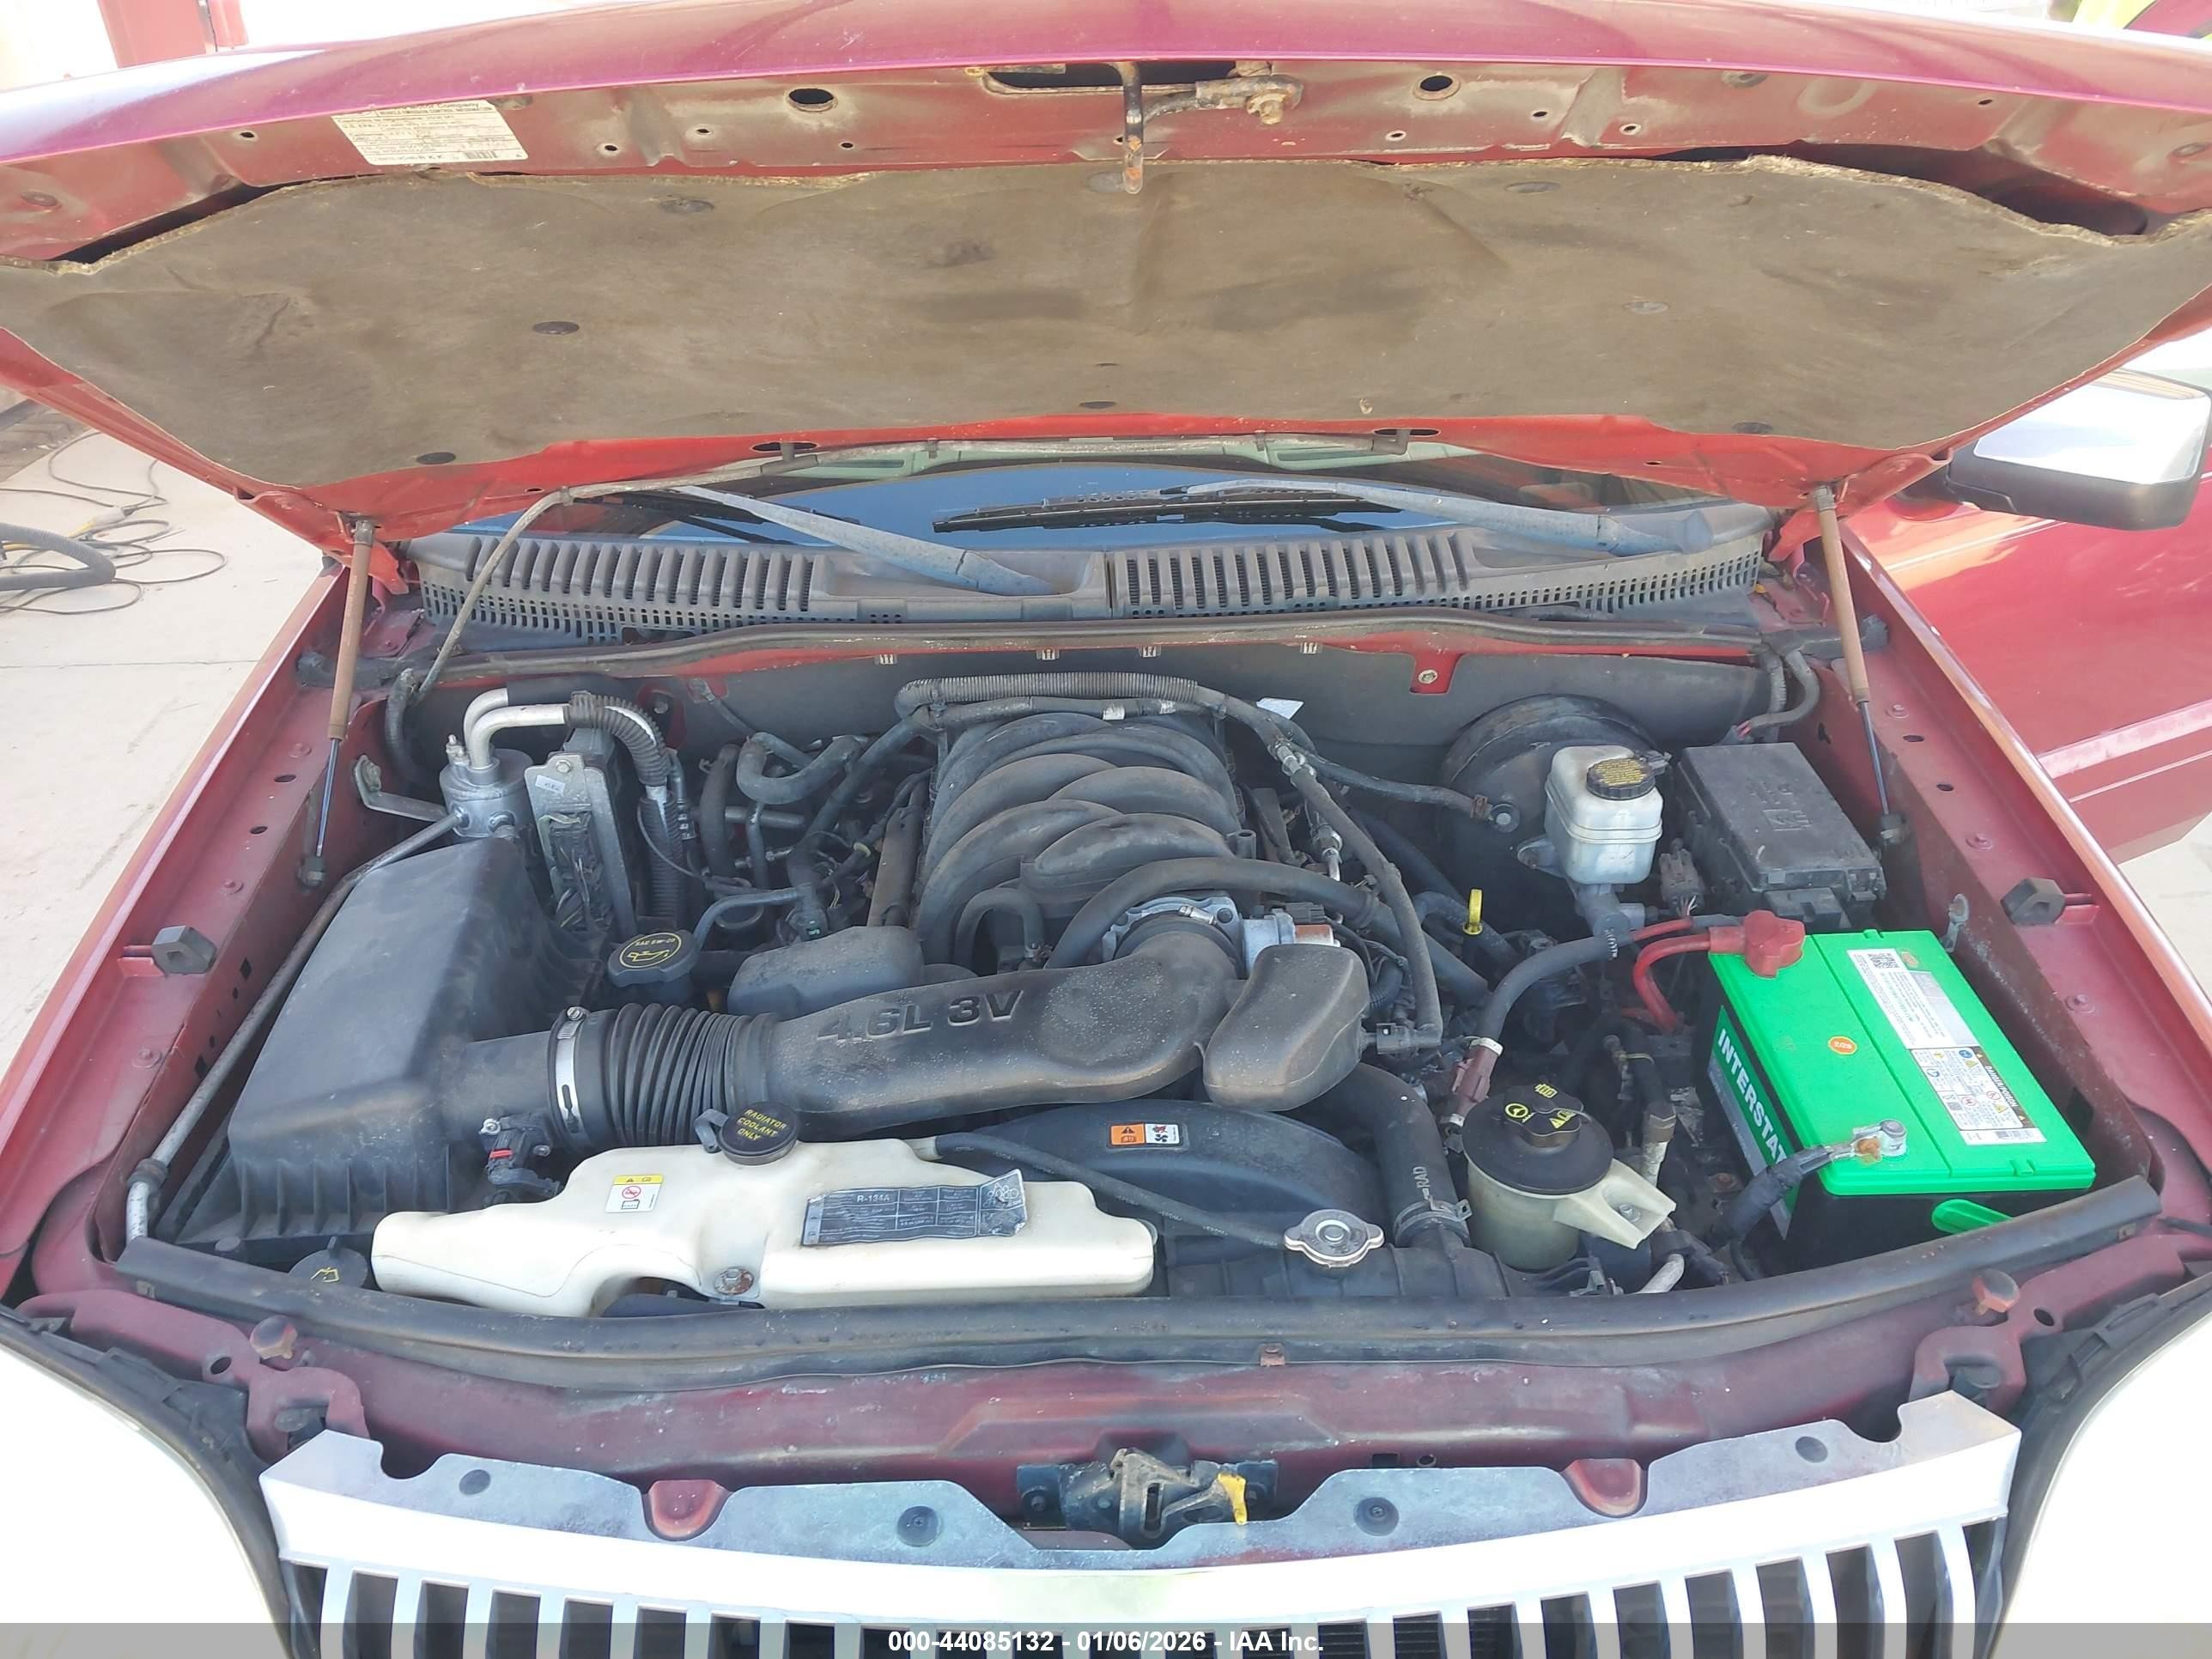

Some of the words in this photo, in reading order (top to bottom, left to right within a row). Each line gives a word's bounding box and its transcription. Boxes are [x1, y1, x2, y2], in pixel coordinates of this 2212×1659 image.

[817, 1004, 933, 1042] 4.6L
[947, 990, 1024, 1027] 3V
[737, 1117, 778, 1137] COOLANT
[744, 1109, 787, 1129] RADIATOR
[737, 1127, 762, 1140] ONLY
[1413, 1166, 1430, 1188] RAD
[857, 1194, 890, 1203] R-134A
